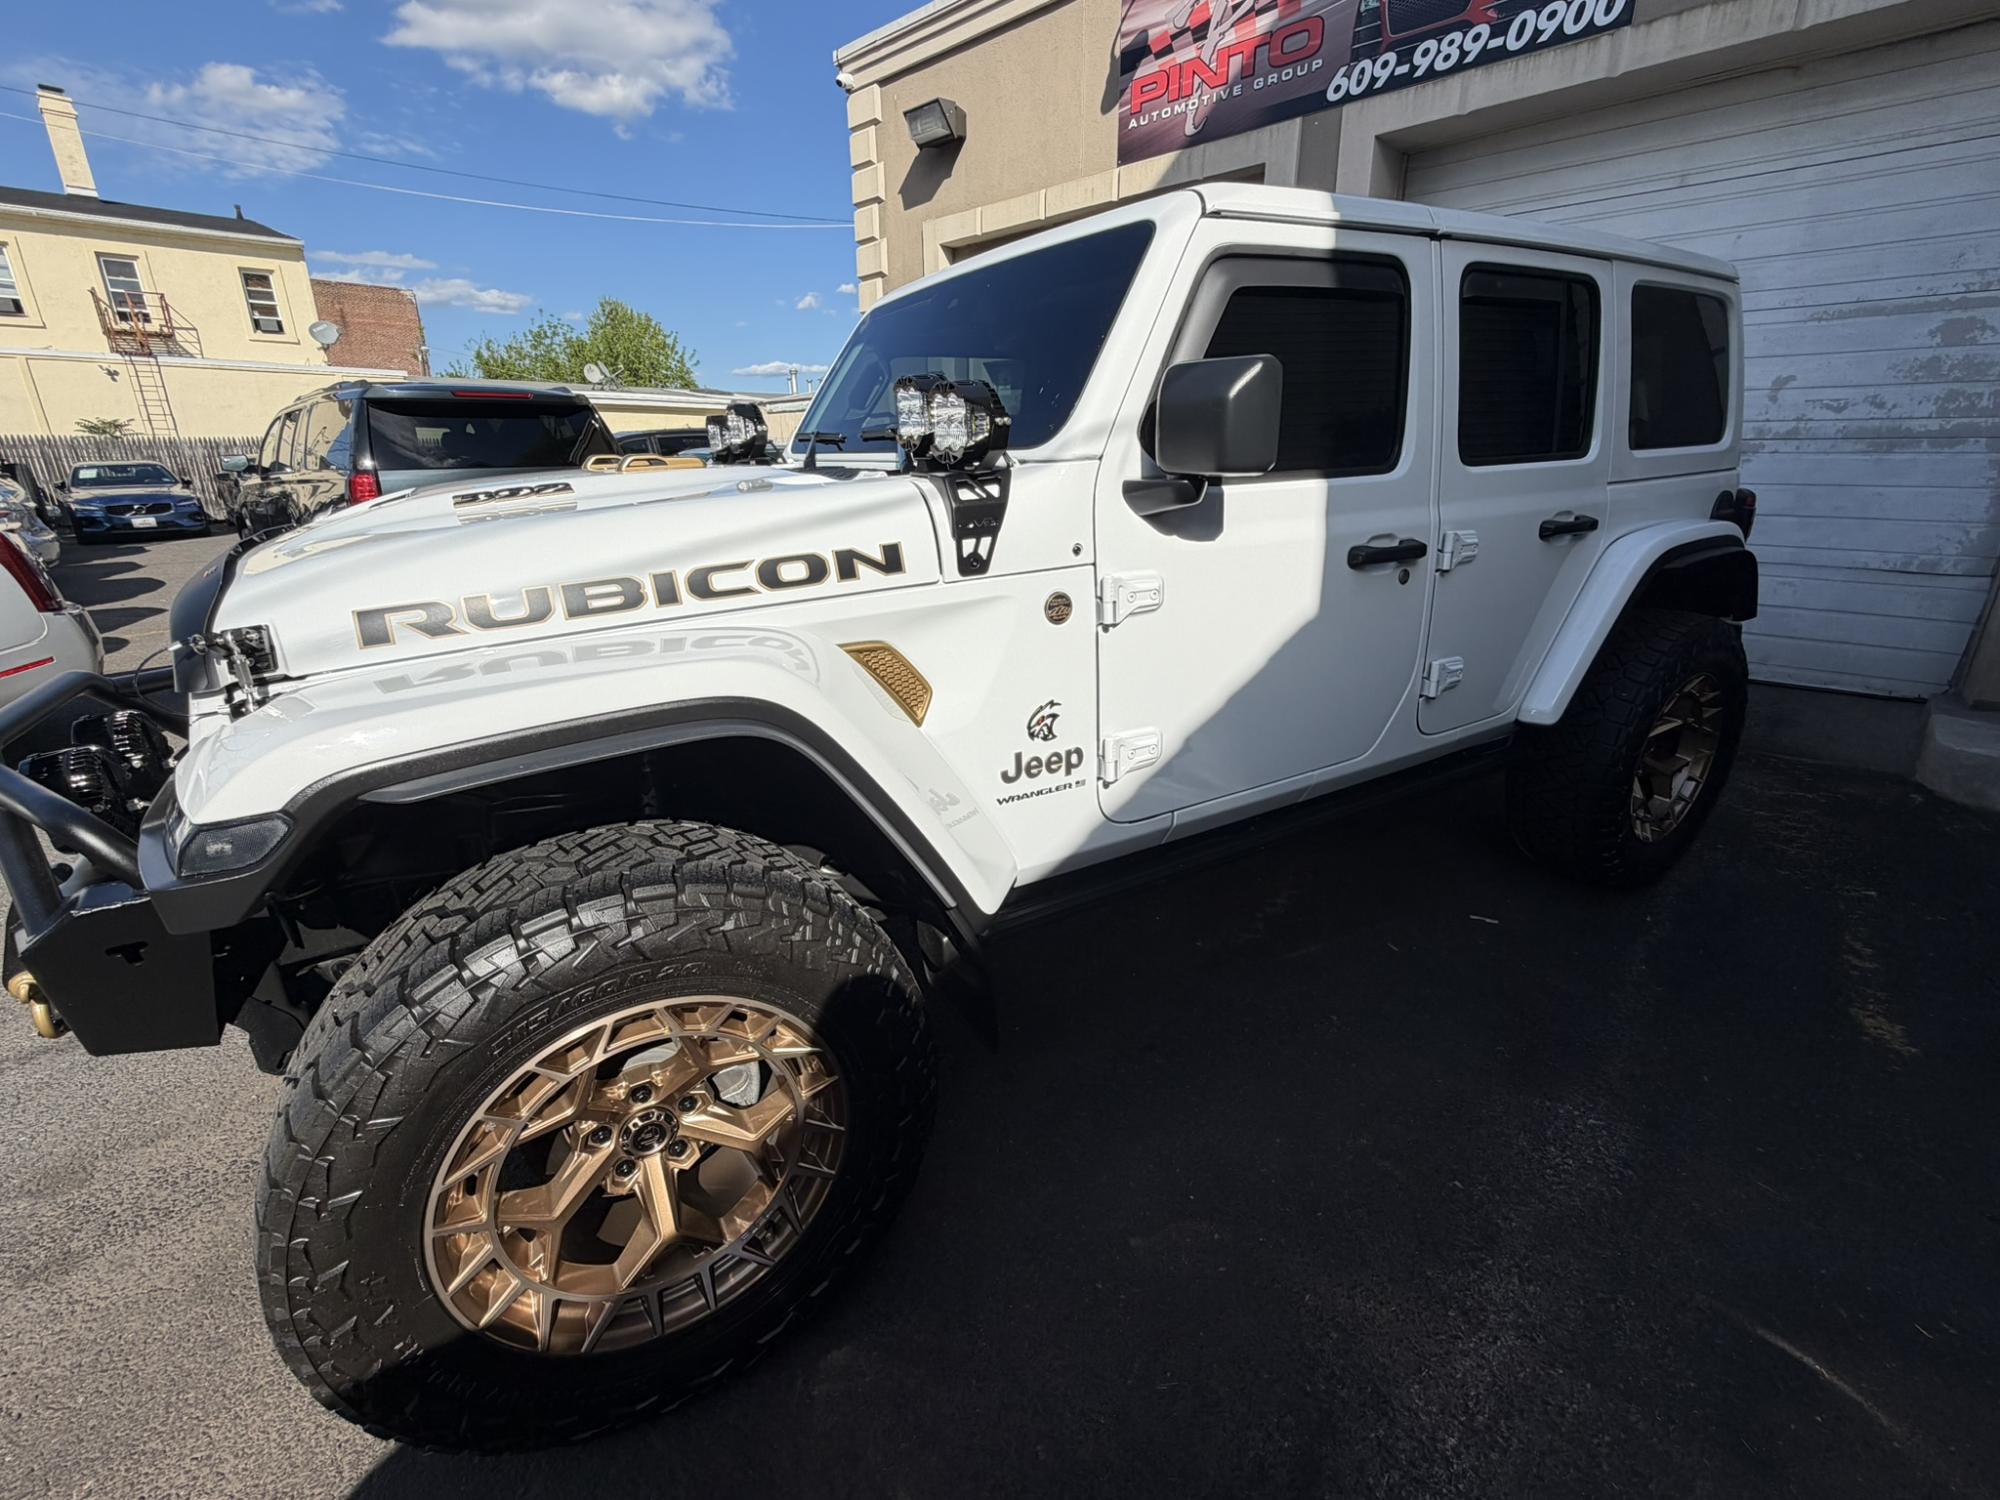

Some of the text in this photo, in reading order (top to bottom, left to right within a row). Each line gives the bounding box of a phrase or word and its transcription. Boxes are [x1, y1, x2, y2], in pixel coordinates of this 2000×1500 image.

[1130, 15, 1324, 115] PINTO
[1326, 0, 1625, 101] 609-989-0900
[1128, 59, 1324, 129] AUTOMOTIVE GROUP
[351, 541, 906, 650] RUBICON
[996, 783, 1073, 806] WRANGLER
[1000, 746, 1084, 784] Jeep
